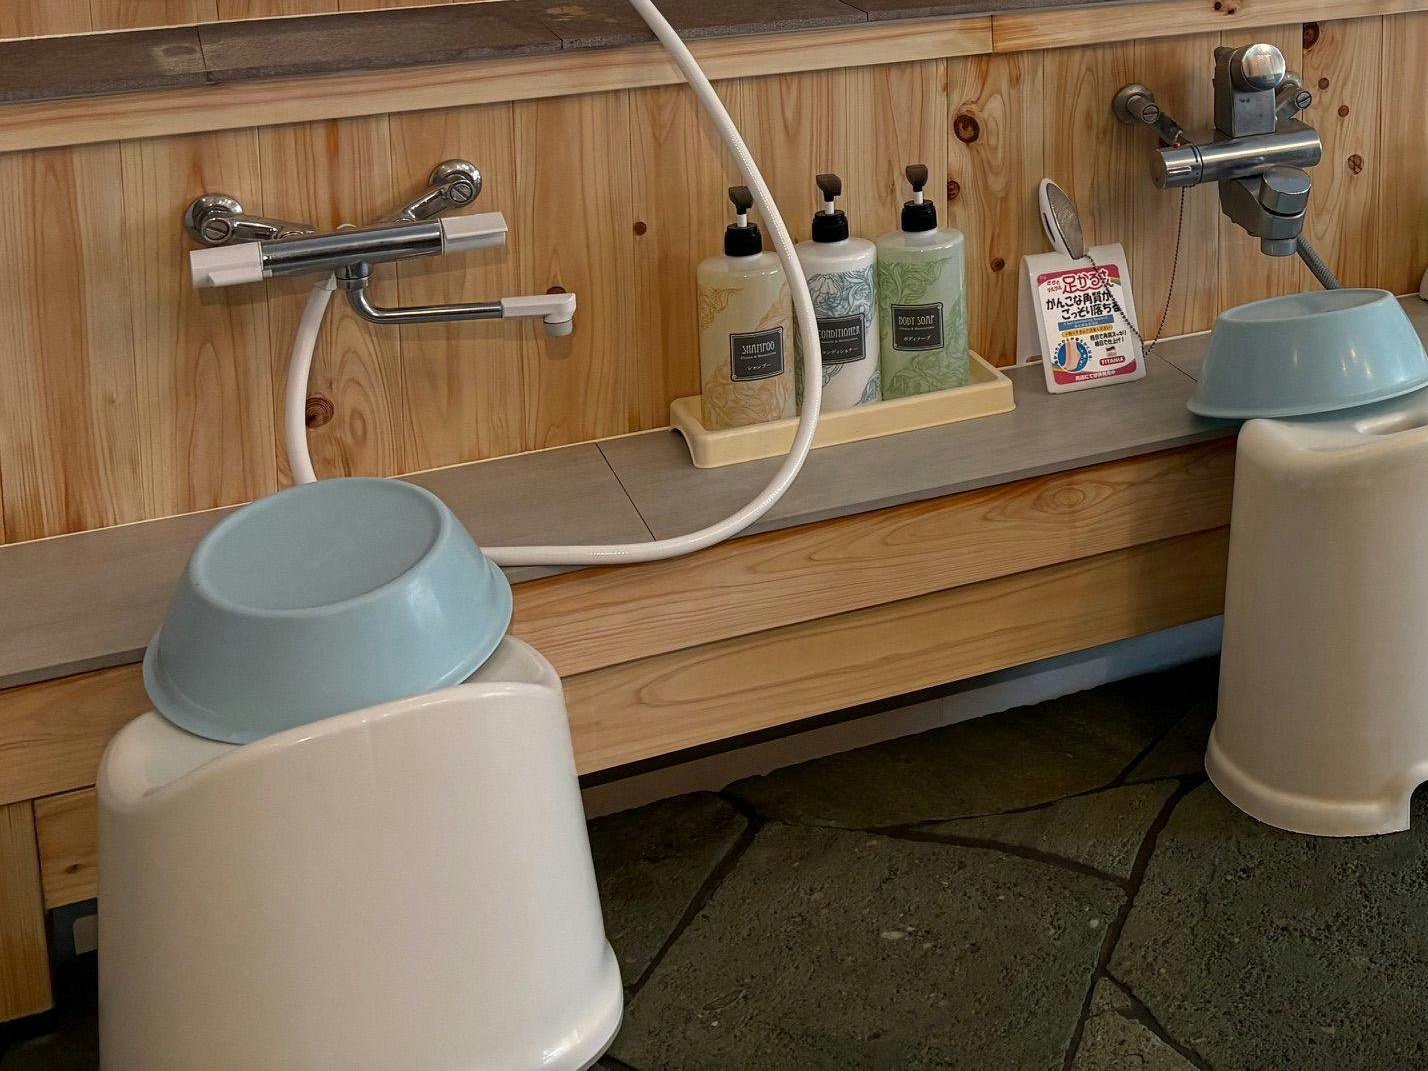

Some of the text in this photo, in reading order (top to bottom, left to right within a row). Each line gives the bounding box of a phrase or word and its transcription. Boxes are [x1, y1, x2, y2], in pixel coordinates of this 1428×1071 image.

[898, 315, 935, 326] BODY SOAP
[741, 340, 775, 355] SHAMPOO
[1101, 356, 1125, 366] TITANIA
